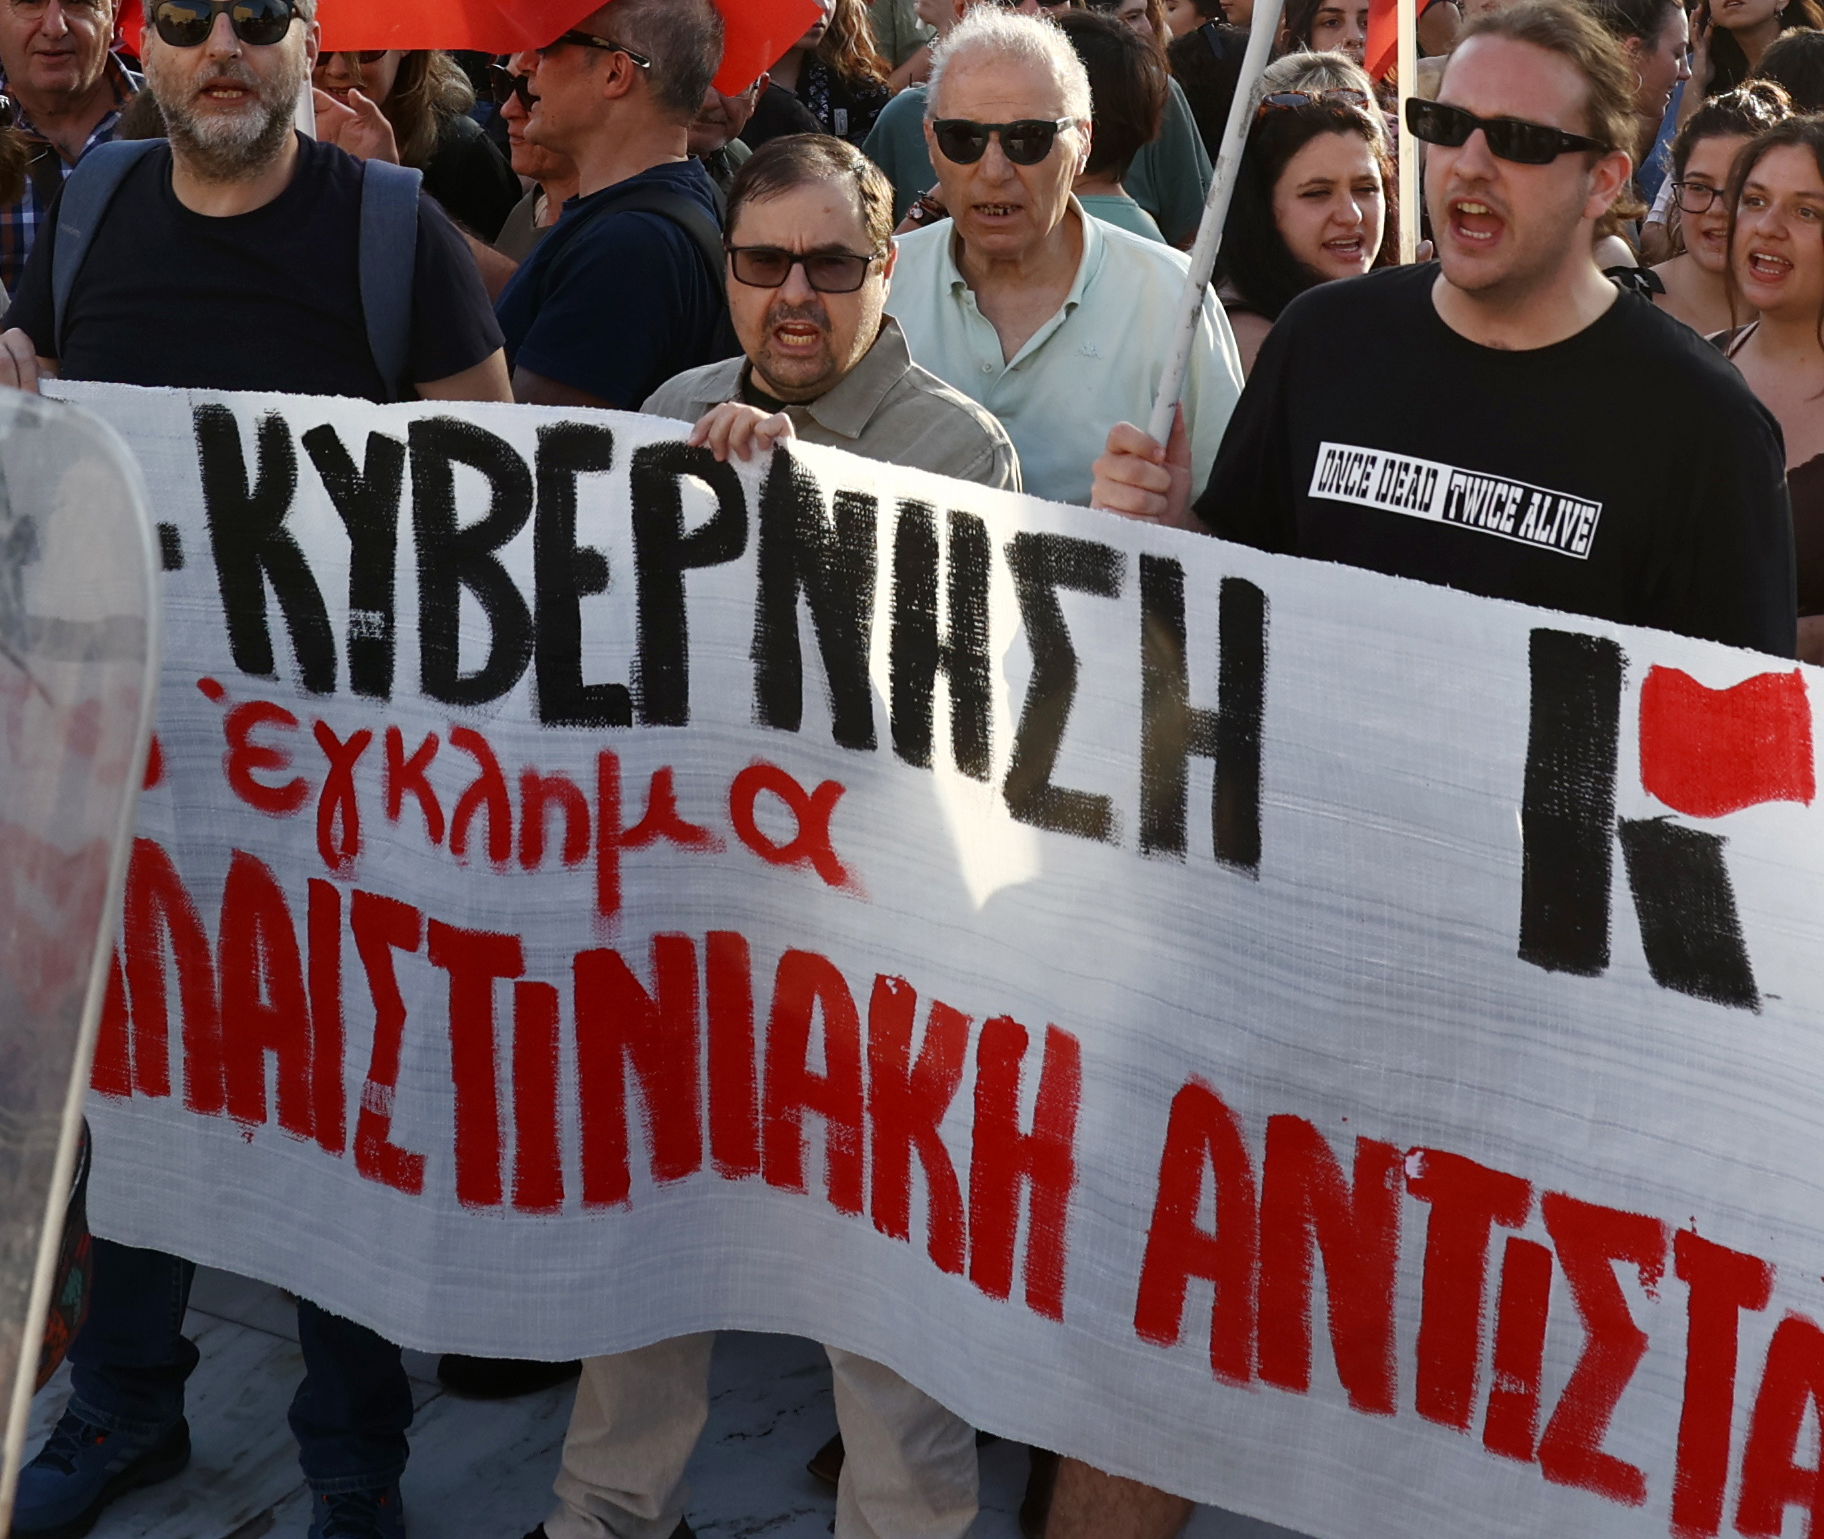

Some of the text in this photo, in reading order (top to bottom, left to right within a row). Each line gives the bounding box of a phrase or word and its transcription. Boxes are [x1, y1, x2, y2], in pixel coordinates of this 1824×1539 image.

[1318, 450, 1596, 553] ONCE DEAD TWICE ALIVE
